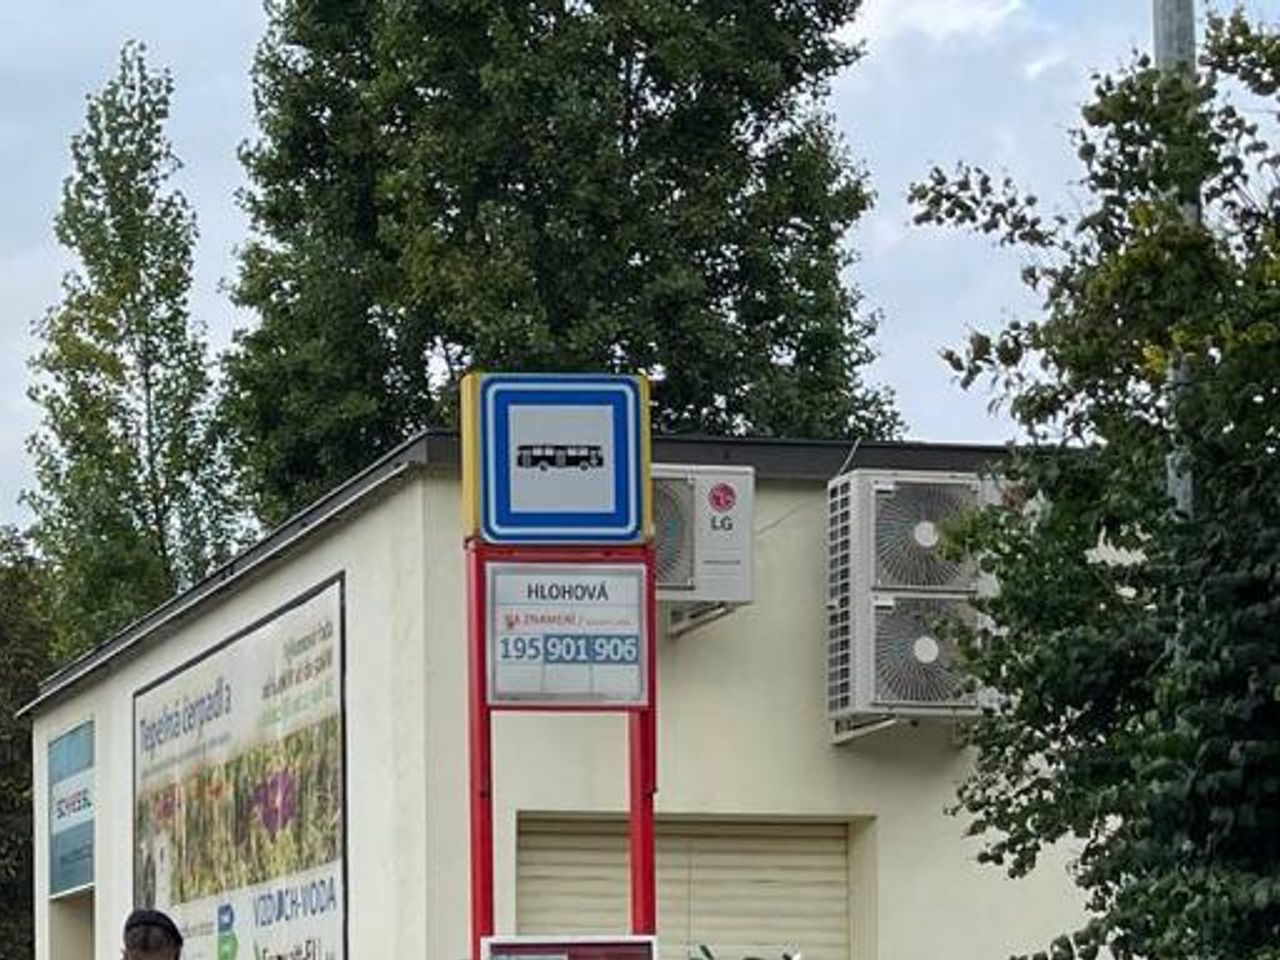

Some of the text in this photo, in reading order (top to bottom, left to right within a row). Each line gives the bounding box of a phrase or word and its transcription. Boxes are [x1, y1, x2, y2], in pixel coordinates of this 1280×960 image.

[711, 515, 733, 531] LG
[527, 580, 609, 601] HLOHOVÁ
[500, 637, 637, 660] 195 901 906
